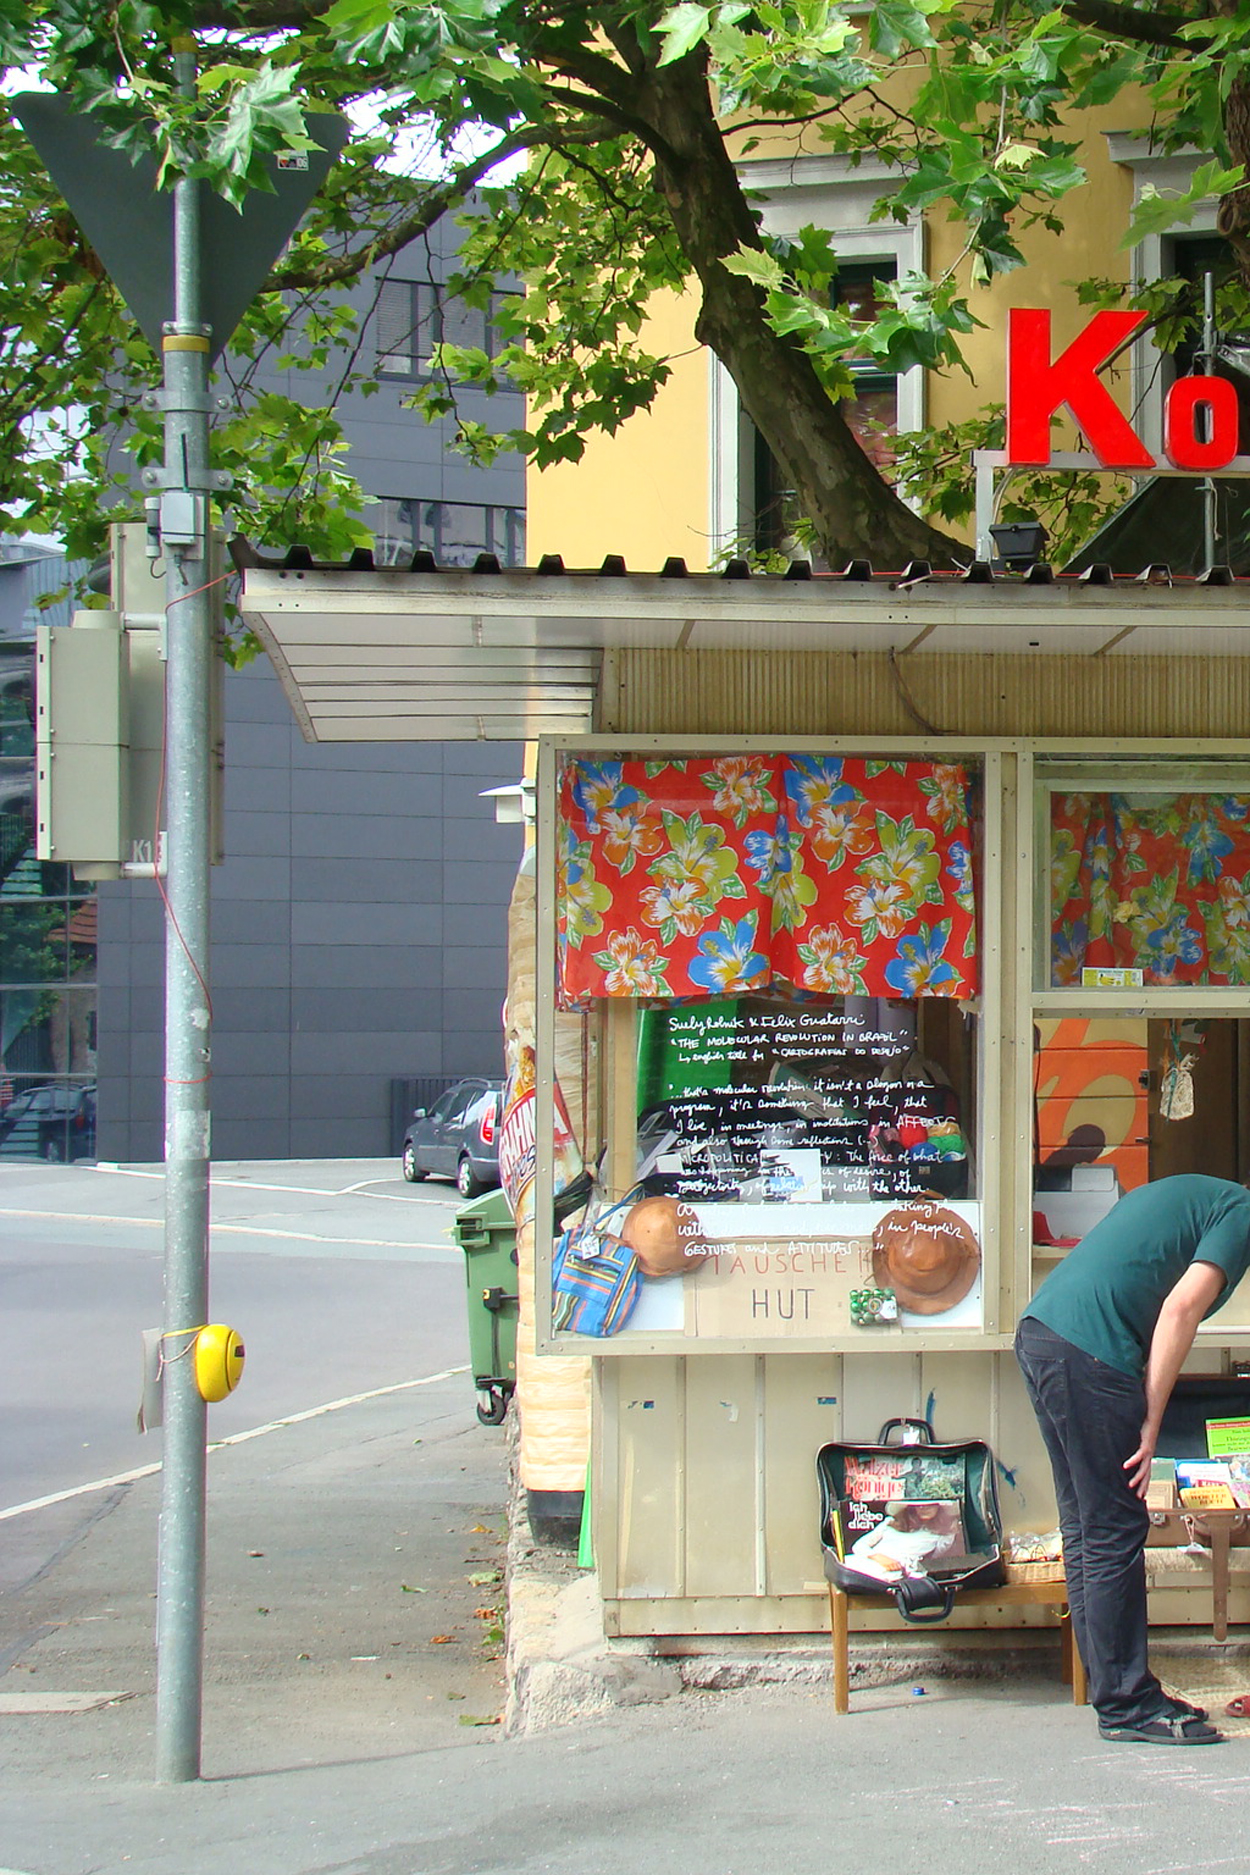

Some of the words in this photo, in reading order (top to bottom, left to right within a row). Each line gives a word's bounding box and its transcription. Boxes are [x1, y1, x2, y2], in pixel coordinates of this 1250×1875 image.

[760, 1014, 796, 1028] Felix
[822, 1096, 845, 1110] that
[903, 1093, 928, 1108] that
[720, 1121, 732, 1131] in
[871, 1178, 890, 1194] the
[887, 1216, 908, 1232] in
[744, 1241, 780, 1255] and
[752, 1287, 816, 1321] HUT
[848, 1518, 875, 1529] dich
